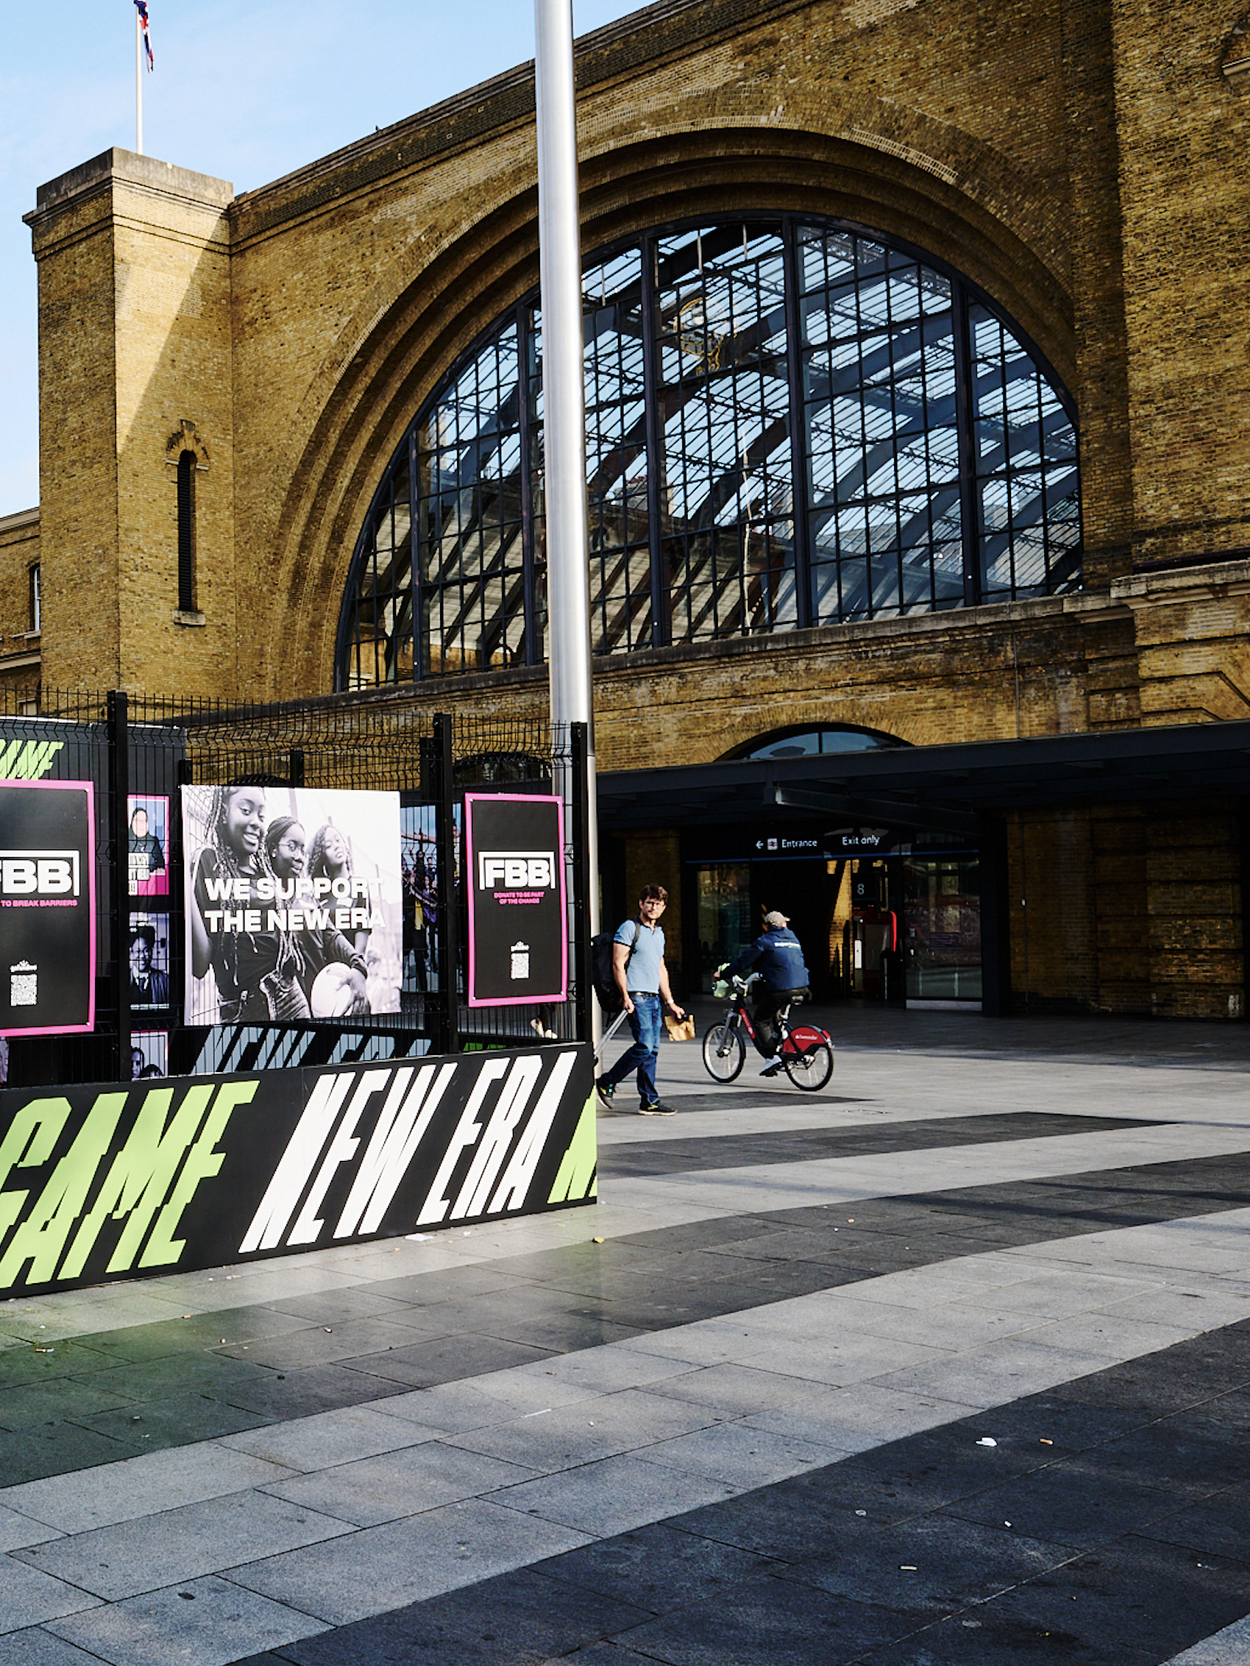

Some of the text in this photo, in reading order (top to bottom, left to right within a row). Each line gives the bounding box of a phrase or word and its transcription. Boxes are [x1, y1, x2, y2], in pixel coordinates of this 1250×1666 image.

[781, 839, 818, 848] Entrance
[842, 835, 880, 846] Exit only
[484, 858, 551, 888] FBB
[204, 878, 384, 901] WE SUPPORT
[857, 883, 864, 895] 8
[204, 908, 385, 932] THE NEW ERA
[237, 1062, 458, 1253] NEW
[416, 1051, 578, 1226] ERA
